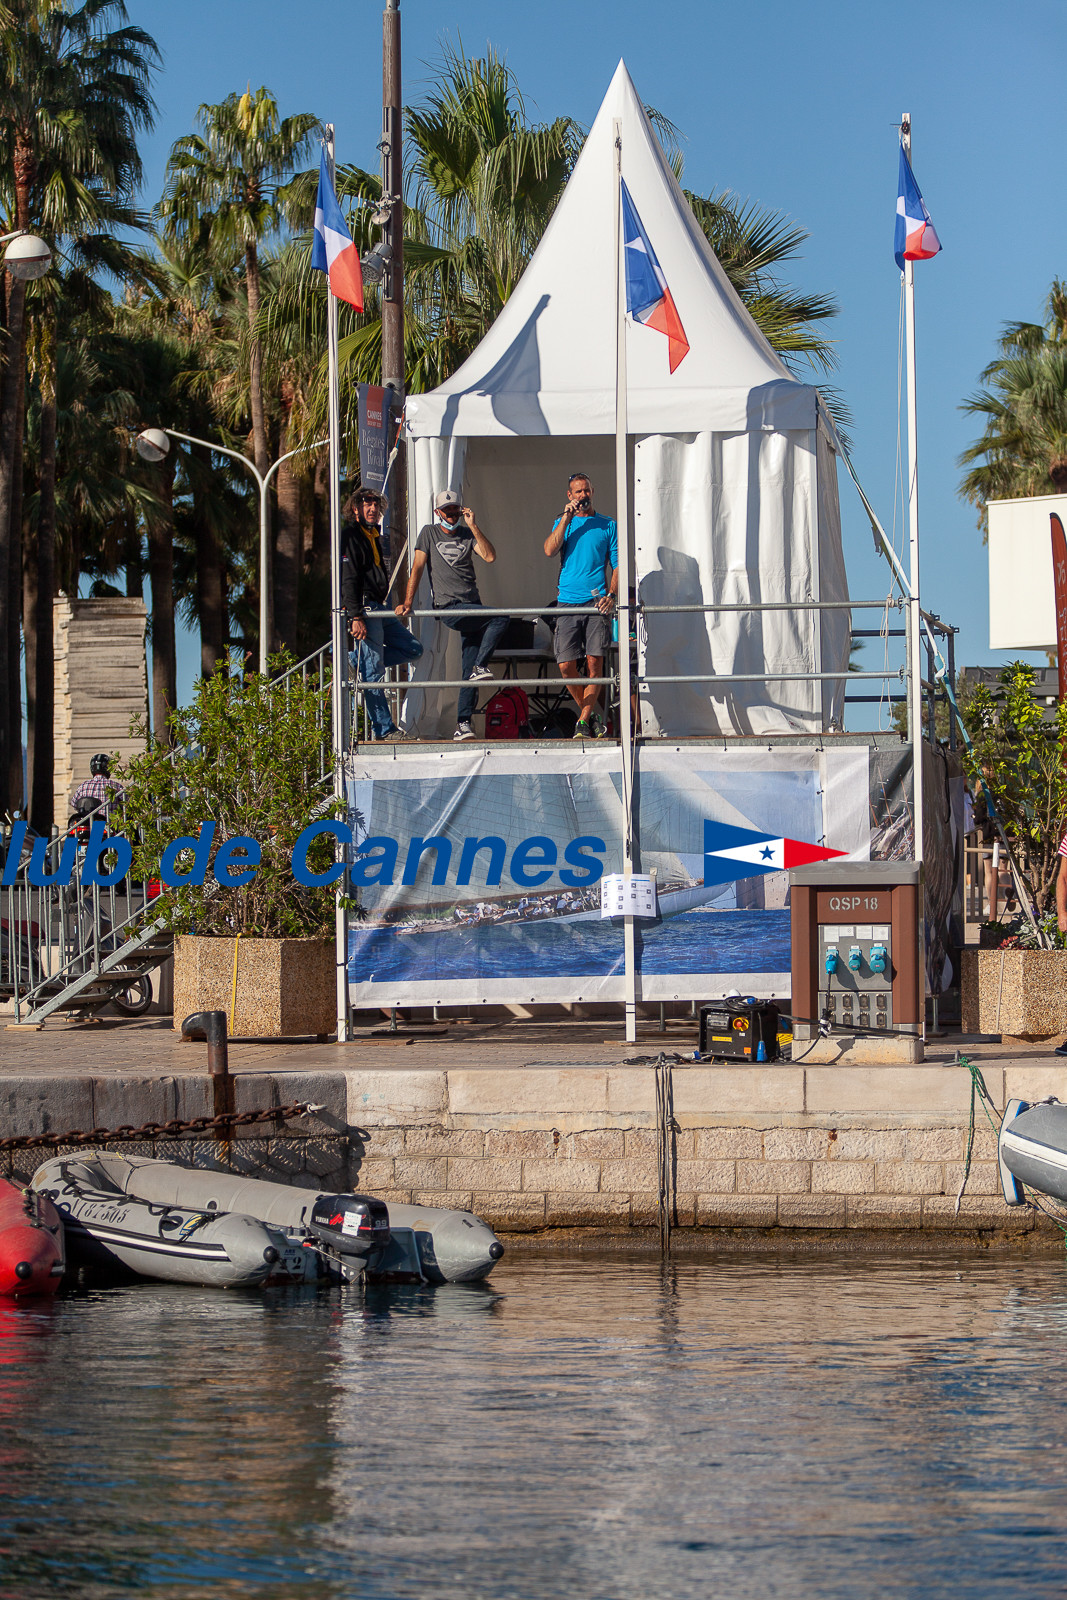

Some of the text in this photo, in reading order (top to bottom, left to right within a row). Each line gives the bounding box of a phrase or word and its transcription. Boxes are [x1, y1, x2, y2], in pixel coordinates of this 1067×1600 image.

[367, 409, 382, 421] CANNES
[829, 897, 879, 911] QSP 18
